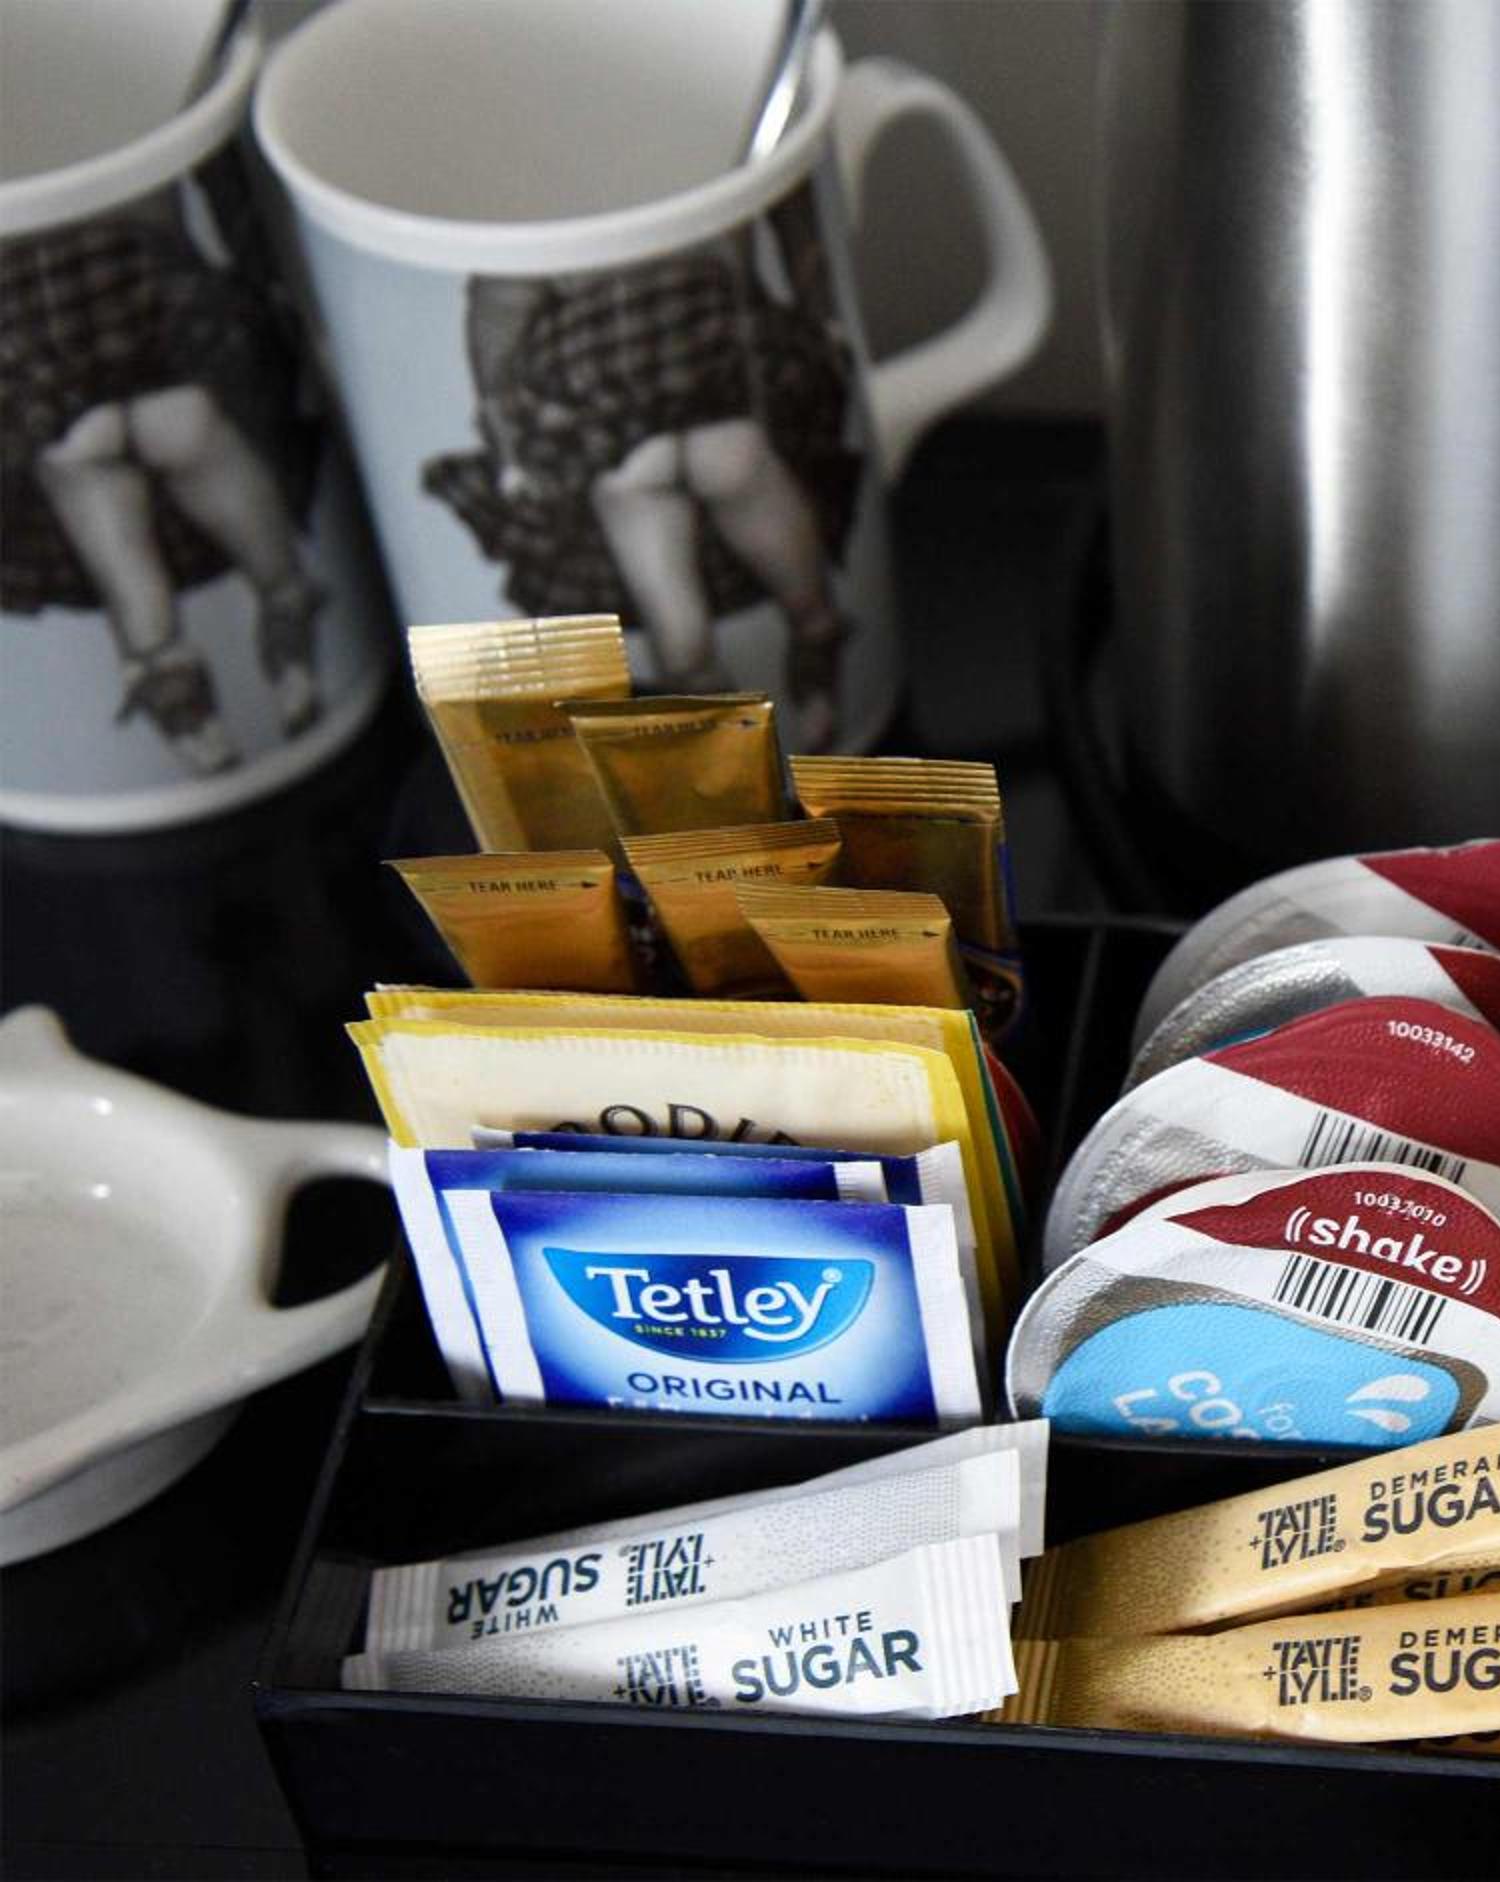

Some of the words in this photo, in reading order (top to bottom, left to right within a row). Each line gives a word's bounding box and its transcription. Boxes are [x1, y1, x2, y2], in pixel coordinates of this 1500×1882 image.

[469, 880, 511, 894] TEAR
[515, 879, 558, 893] HERE
[1387, 1020, 1476, 1063] 10033142
[634, 1324, 685, 1338] SINCE
[627, 1372, 843, 1404] ORIGINAL
[1257, 1493, 1337, 1538] TATE
[447, 1552, 603, 1625] SUGAR
[626, 1564, 706, 1608] TATE
[471, 1603, 560, 1640] WHITE
[768, 1611, 873, 1649] WHITE
[731, 1629, 923, 1702] SUGAR
[1272, 1635, 1362, 1670] TATE
